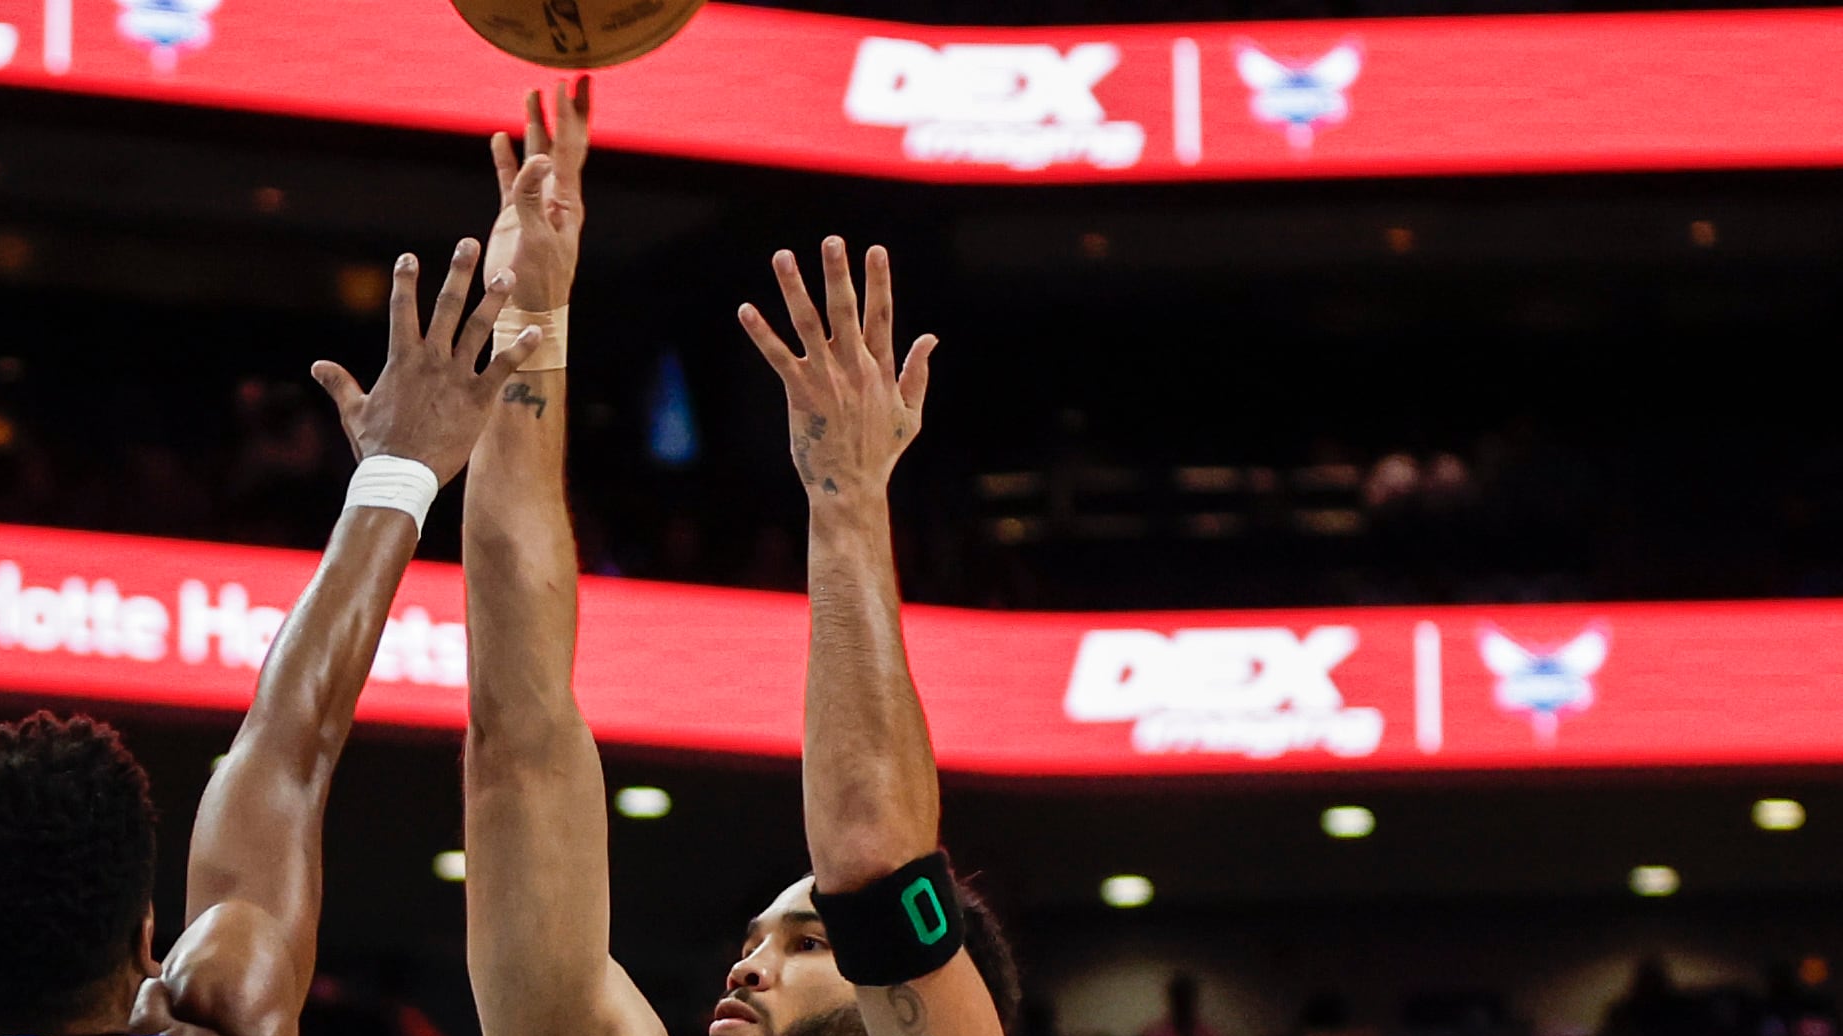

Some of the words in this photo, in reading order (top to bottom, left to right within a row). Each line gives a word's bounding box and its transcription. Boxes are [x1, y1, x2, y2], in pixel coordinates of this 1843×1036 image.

[844, 36, 1122, 127] DEX
[1063, 626, 1360, 722] DEX
[901, 876, 948, 946] 0
